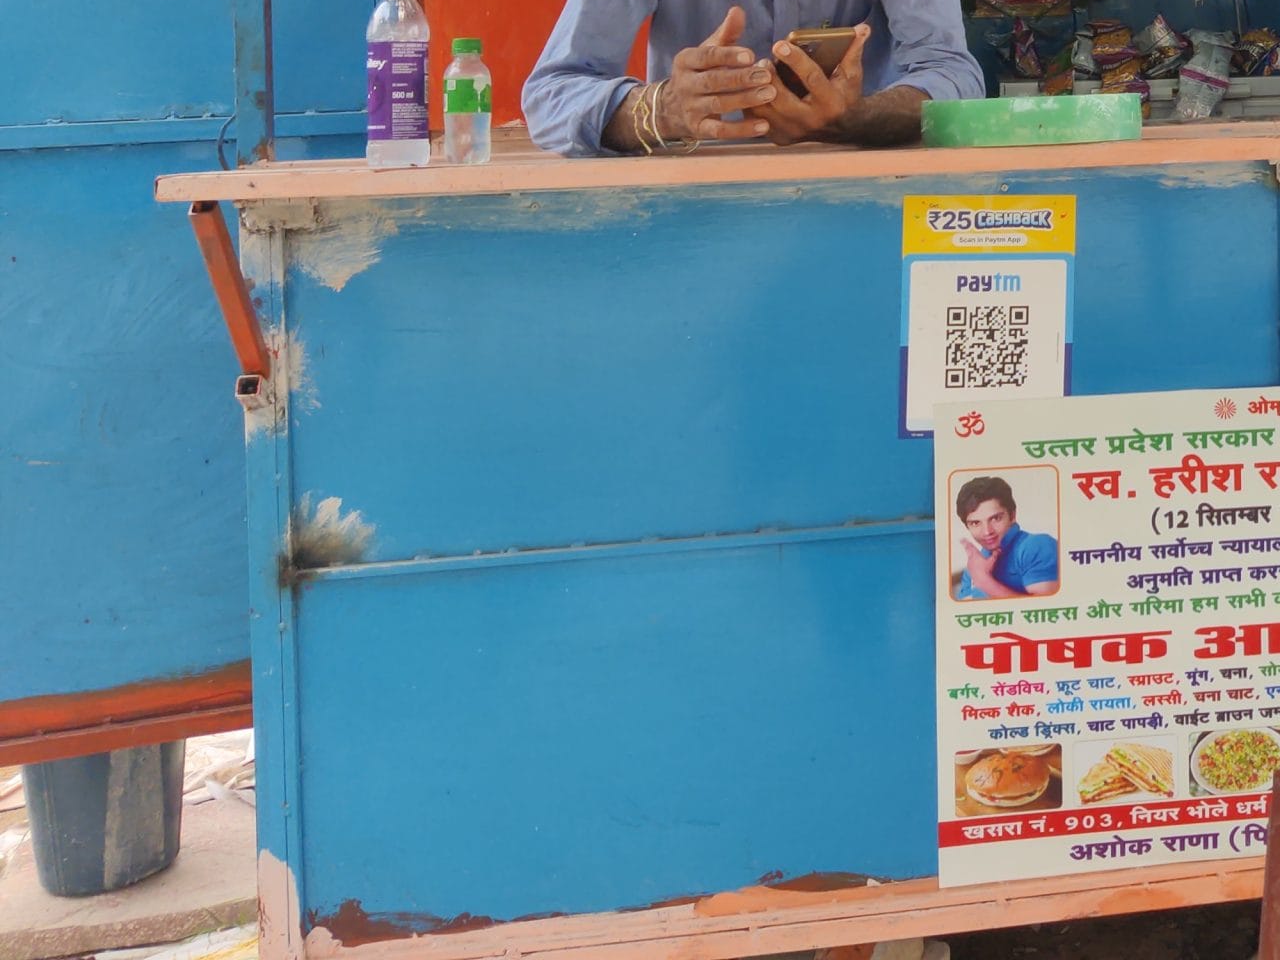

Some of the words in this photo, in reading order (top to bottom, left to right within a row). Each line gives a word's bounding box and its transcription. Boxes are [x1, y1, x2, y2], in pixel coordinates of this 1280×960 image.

[929, 211, 971, 230] ₹25
[956, 272, 1021, 292] paytm
[1022, 438, 1096, 459] उत्तर
[1106, 428, 1173, 453] प्रदेश
[1183, 428, 1275, 449] सरकार
[1072, 470, 1137, 500] स्व.
[1149, 454, 1244, 499] हरीश
[1151, 506, 1189, 534] (12
[1198, 503, 1272, 527] सितम्बर
[1069, 543, 1142, 565] माननीय
[1150, 538, 1213, 560] सर्वोच्च
[1126, 565, 1193, 593] अनुमति
[1200, 567, 1242, 584] प्राप्त
[955, 611, 1014, 628] उनका
[1020, 606, 1078, 624] साहस
[1086, 597, 1122, 619] और
[1130, 593, 1184, 615] गरिमा
[1190, 594, 1218, 613] हम
[1226, 589, 1266, 609] सभी
[960, 630, 1172, 674] पोषक
[947, 685, 985, 700] बर्गर,
[1087, 676, 1122, 690] चाट,
[1220, 667, 1254, 680] चना,
[961, 705, 1000, 721] मिल्क
[1089, 696, 1136, 711] रायता,
[1142, 690, 1188, 708] लस्सी,
[1193, 689, 1221, 704] चना
[1226, 687, 1260, 702] चाट,
[988, 722, 1029, 740] कोल्ड
[1086, 720, 1116, 732] चाट
[1173, 710, 1210, 726] वाईट
[1214, 708, 1254, 722] ब्राउन
[962, 821, 1022, 840] खसरा
[1028, 815, 1055, 838] नं.
[1065, 812, 1122, 832] 903,
[1130, 806, 1180, 826] नियर
[1186, 798, 1228, 820] भोले
[1236, 795, 1268, 815] धर्म
[1068, 835, 1152, 861] अशोक
[1159, 830, 1220, 854] राणा
